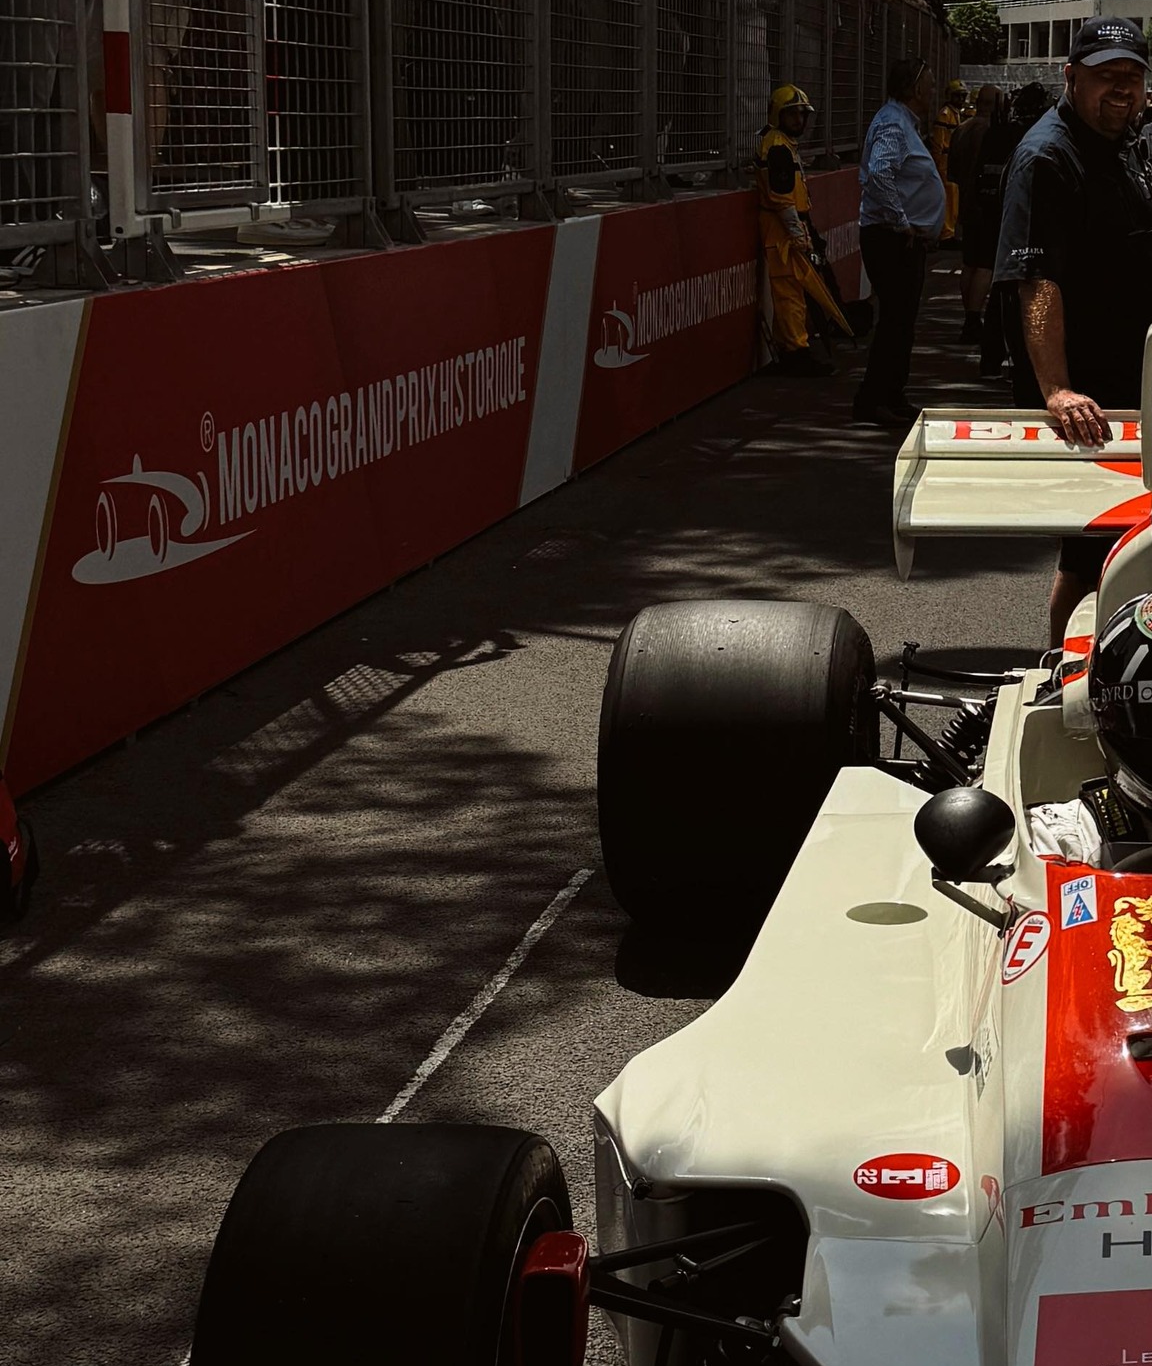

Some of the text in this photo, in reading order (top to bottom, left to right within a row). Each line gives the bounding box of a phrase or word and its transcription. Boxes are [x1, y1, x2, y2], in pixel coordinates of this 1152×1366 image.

[1067, 880, 1089, 894] OFF
[1007, 925, 1043, 968] E
[857, 1168, 878, 1185] 22
